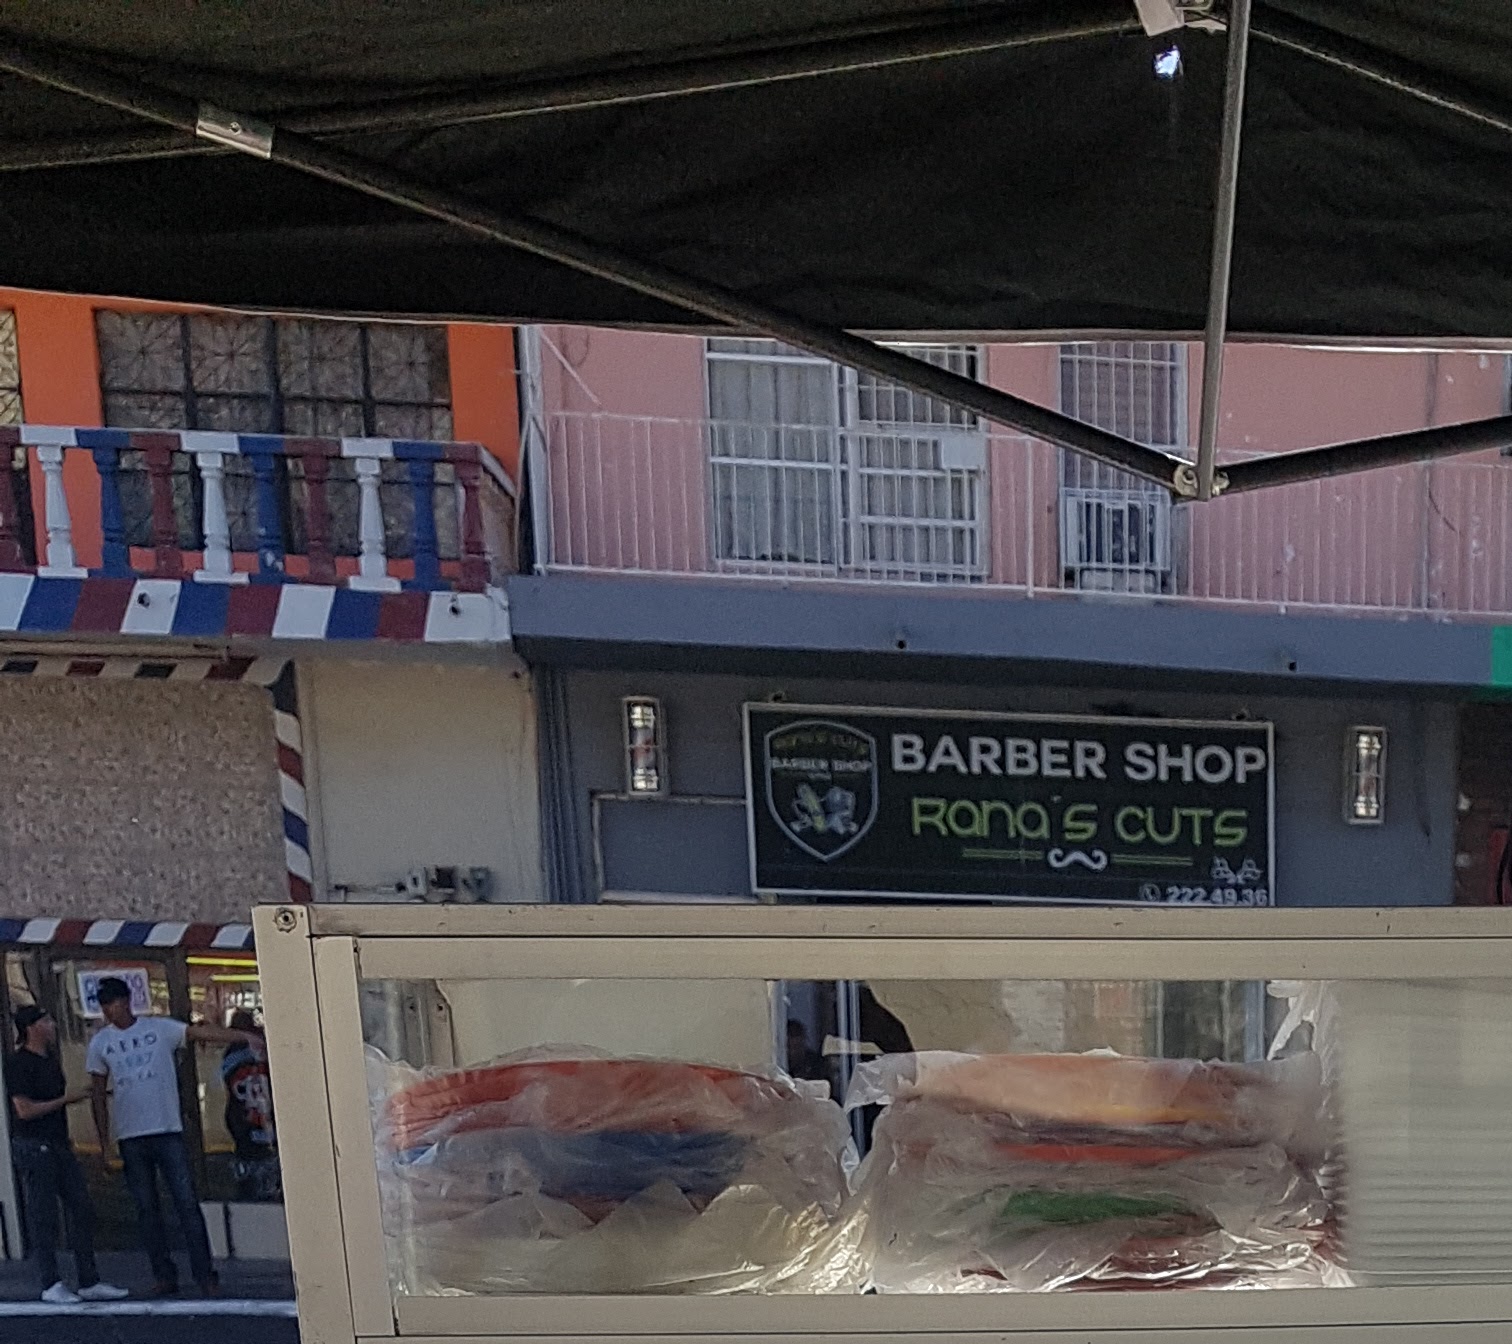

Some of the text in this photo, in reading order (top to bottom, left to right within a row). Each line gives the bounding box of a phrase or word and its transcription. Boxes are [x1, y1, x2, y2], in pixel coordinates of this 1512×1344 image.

[891, 733, 1107, 779] BARBER
[1124, 742, 1266, 783] SHOP
[1115, 806, 1248, 847] CUTS
